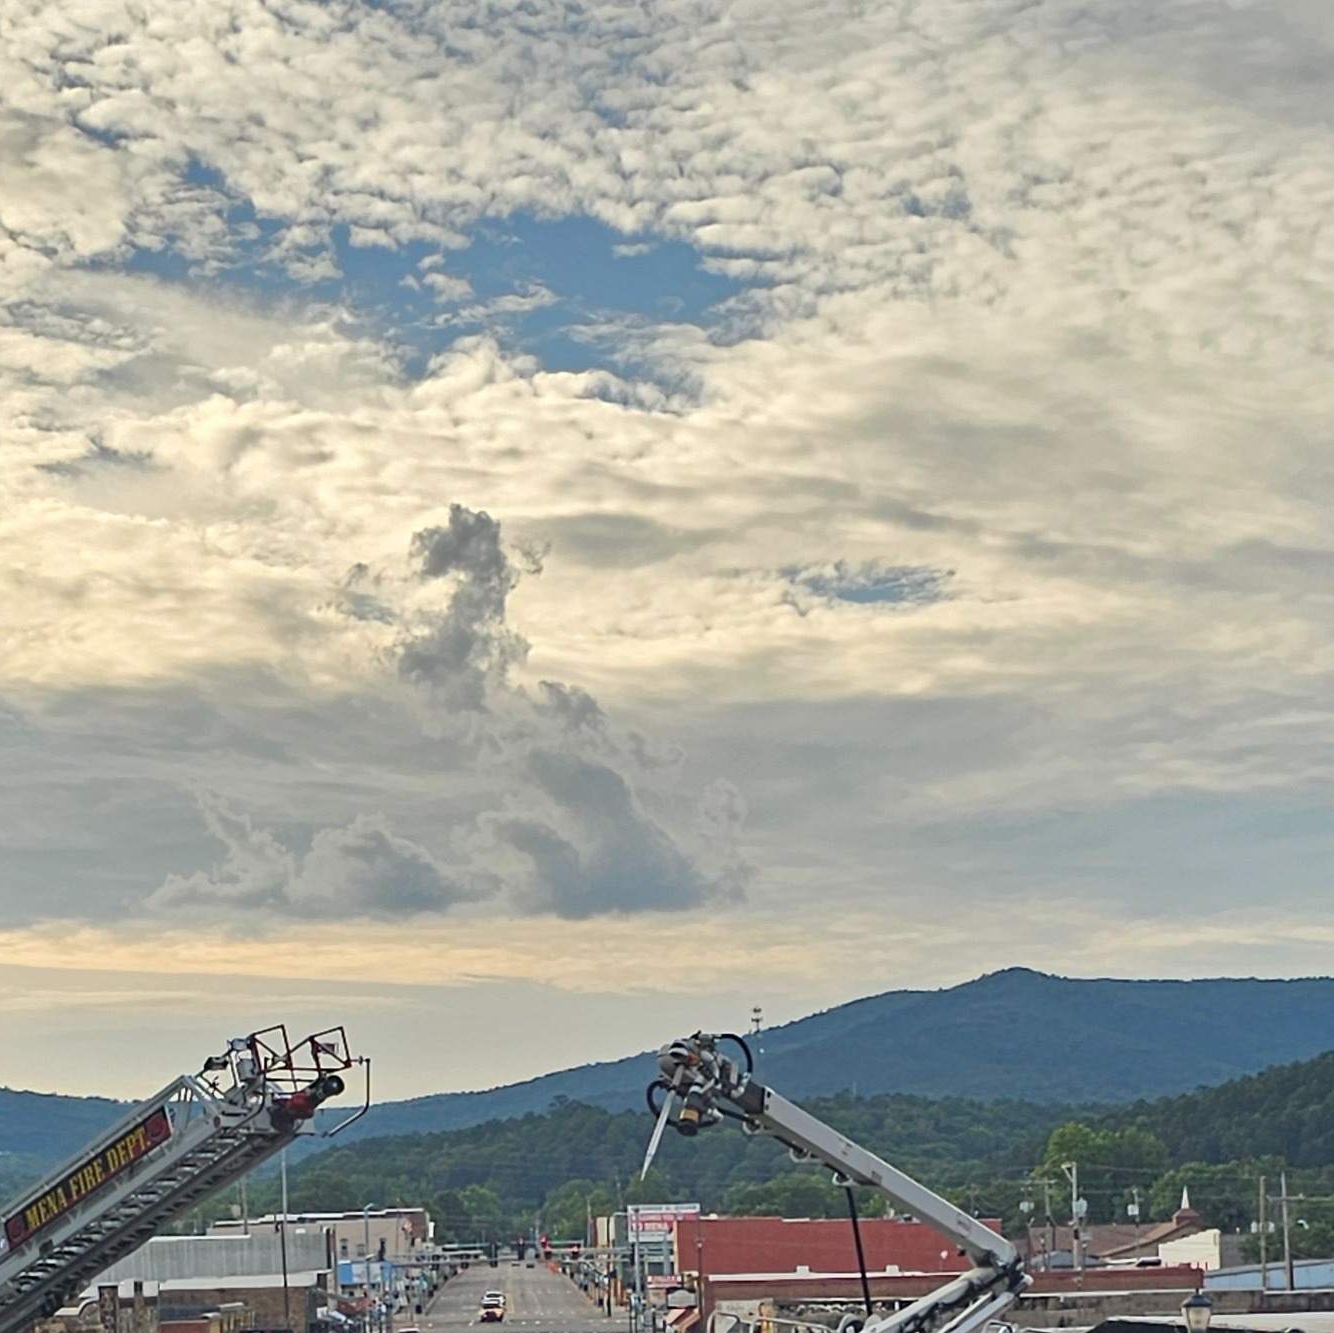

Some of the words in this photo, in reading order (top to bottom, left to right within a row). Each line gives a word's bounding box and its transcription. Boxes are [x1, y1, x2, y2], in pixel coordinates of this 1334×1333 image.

[24, 1186, 68, 1232] MENA
[69, 1157, 106, 1201] FIRE
[106, 1126, 152, 1172] DEPT.
